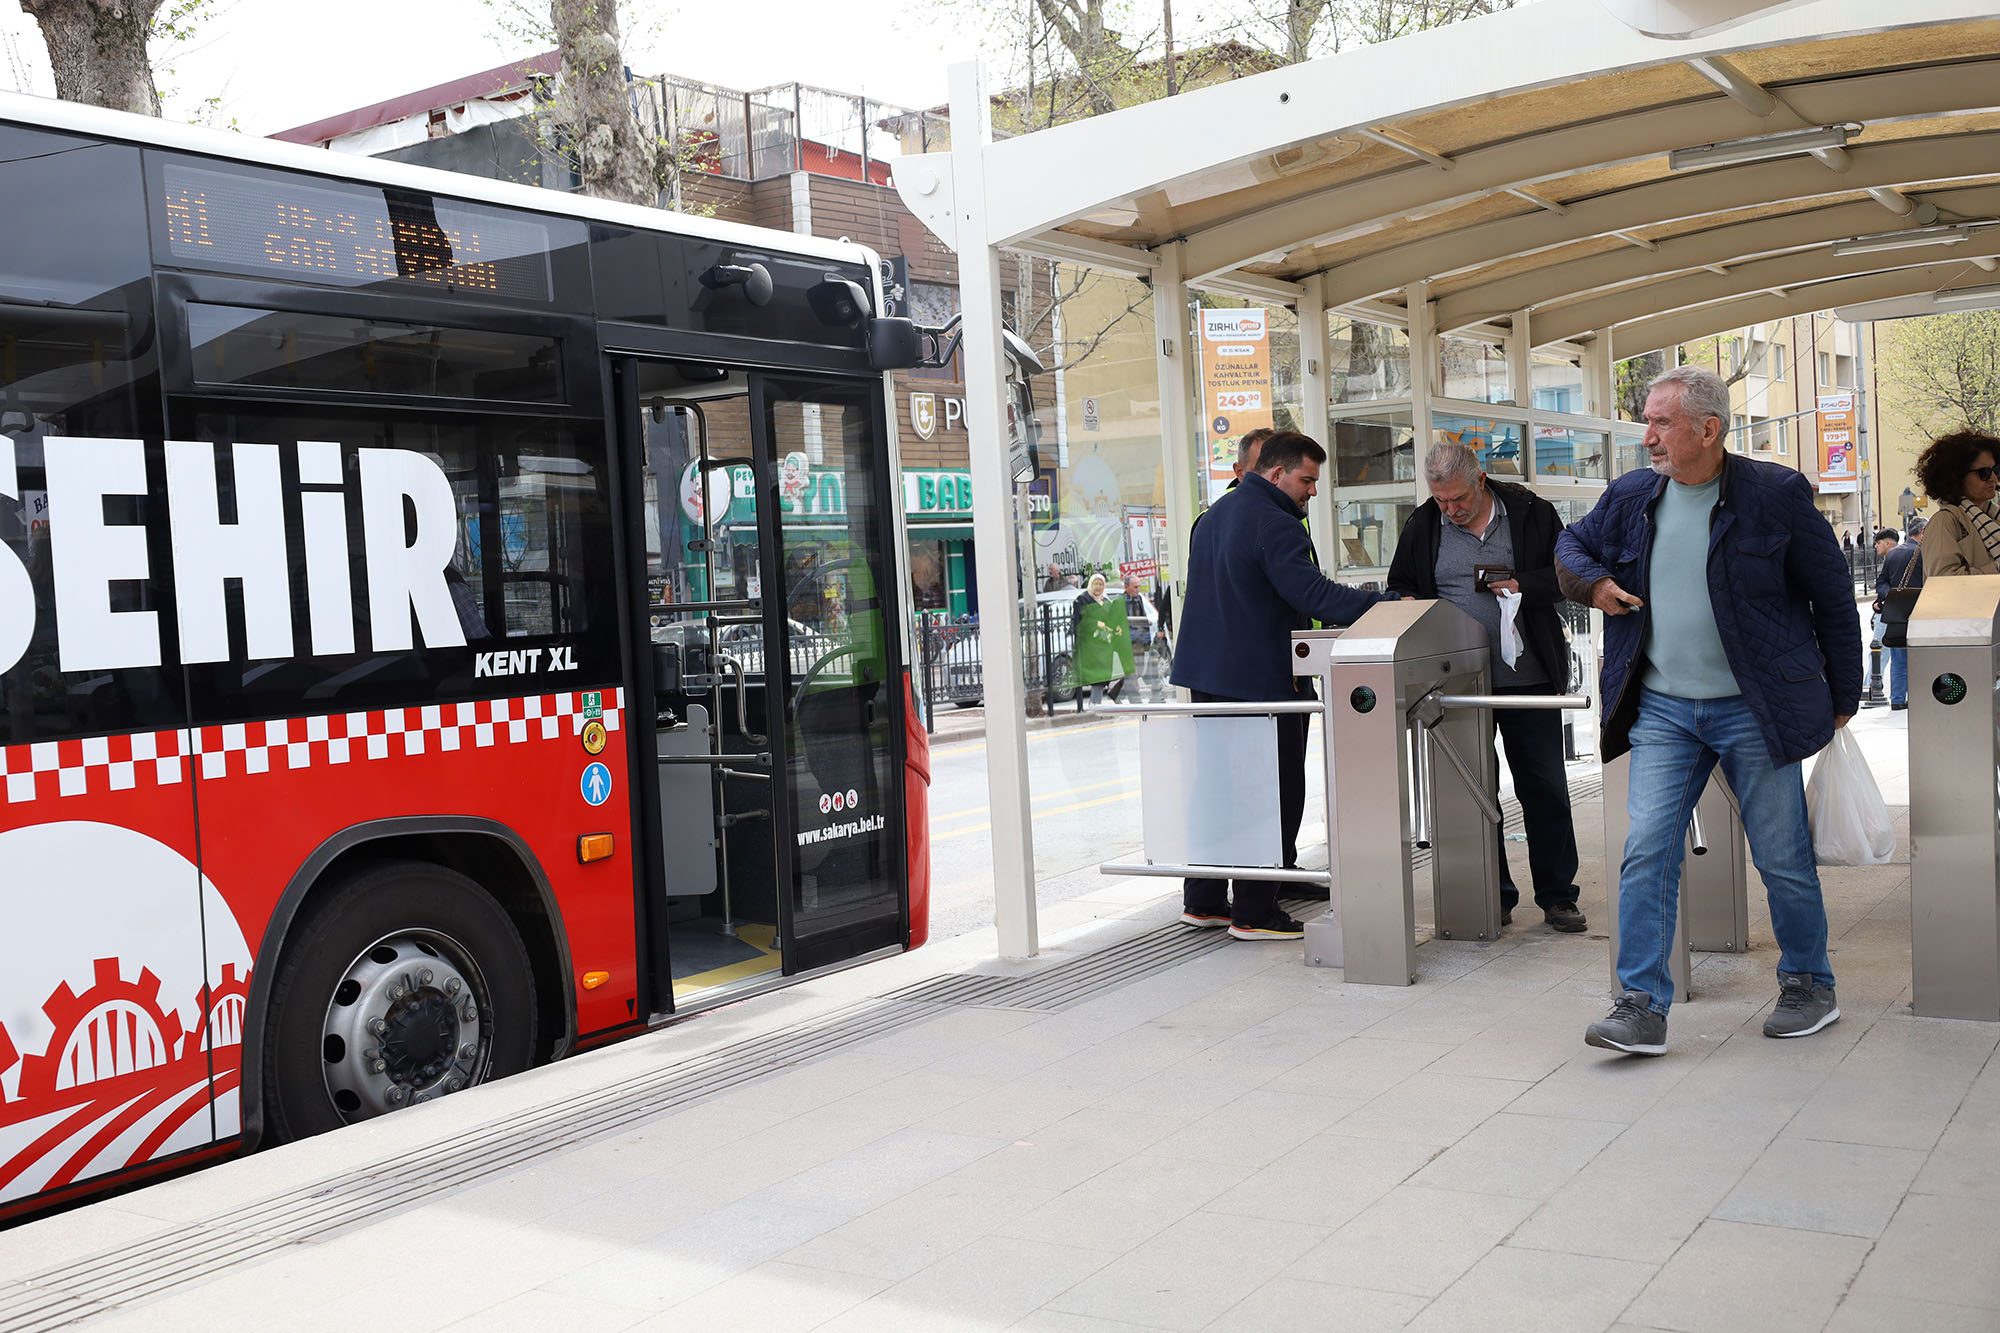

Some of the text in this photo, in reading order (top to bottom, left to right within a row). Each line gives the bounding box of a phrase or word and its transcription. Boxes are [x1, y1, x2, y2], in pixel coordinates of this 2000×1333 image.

[474, 646, 578, 678] KENT XL
[797, 815, 885, 846] www.sakarya.bel.tr
